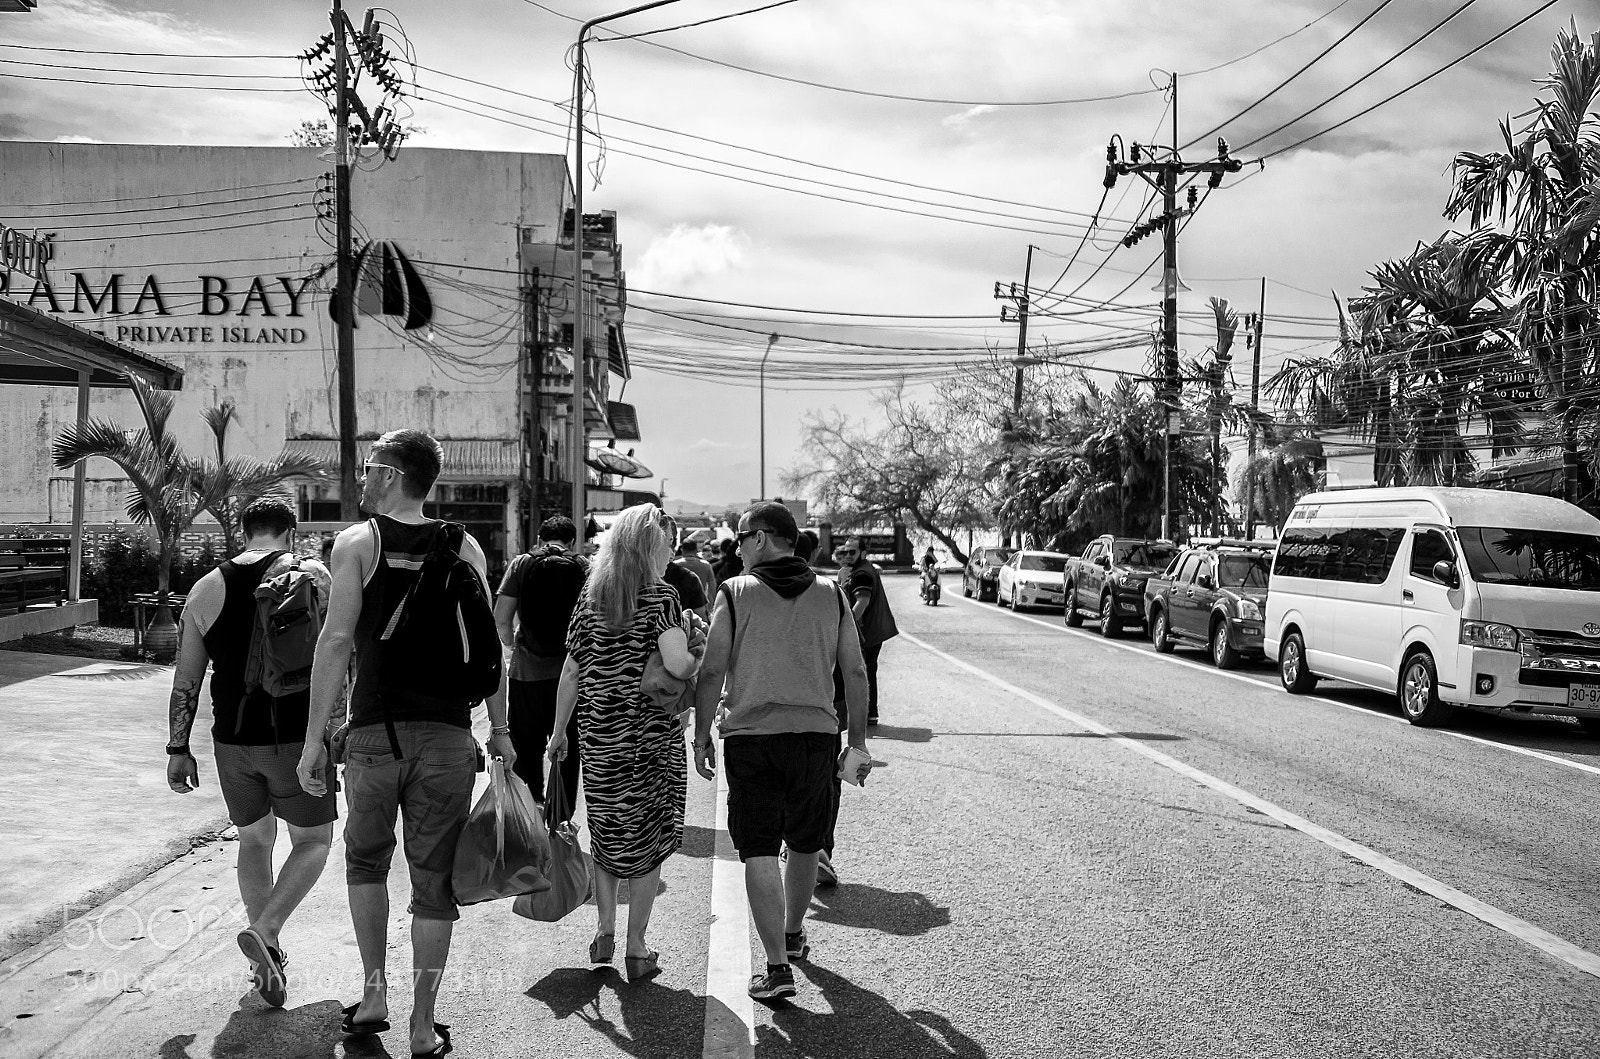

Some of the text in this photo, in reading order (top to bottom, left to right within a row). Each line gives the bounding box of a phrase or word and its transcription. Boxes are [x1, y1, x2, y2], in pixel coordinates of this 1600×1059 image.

[198, 275, 312, 317] BAY
[116, 326, 306, 344] PRIVATE ISLAND
